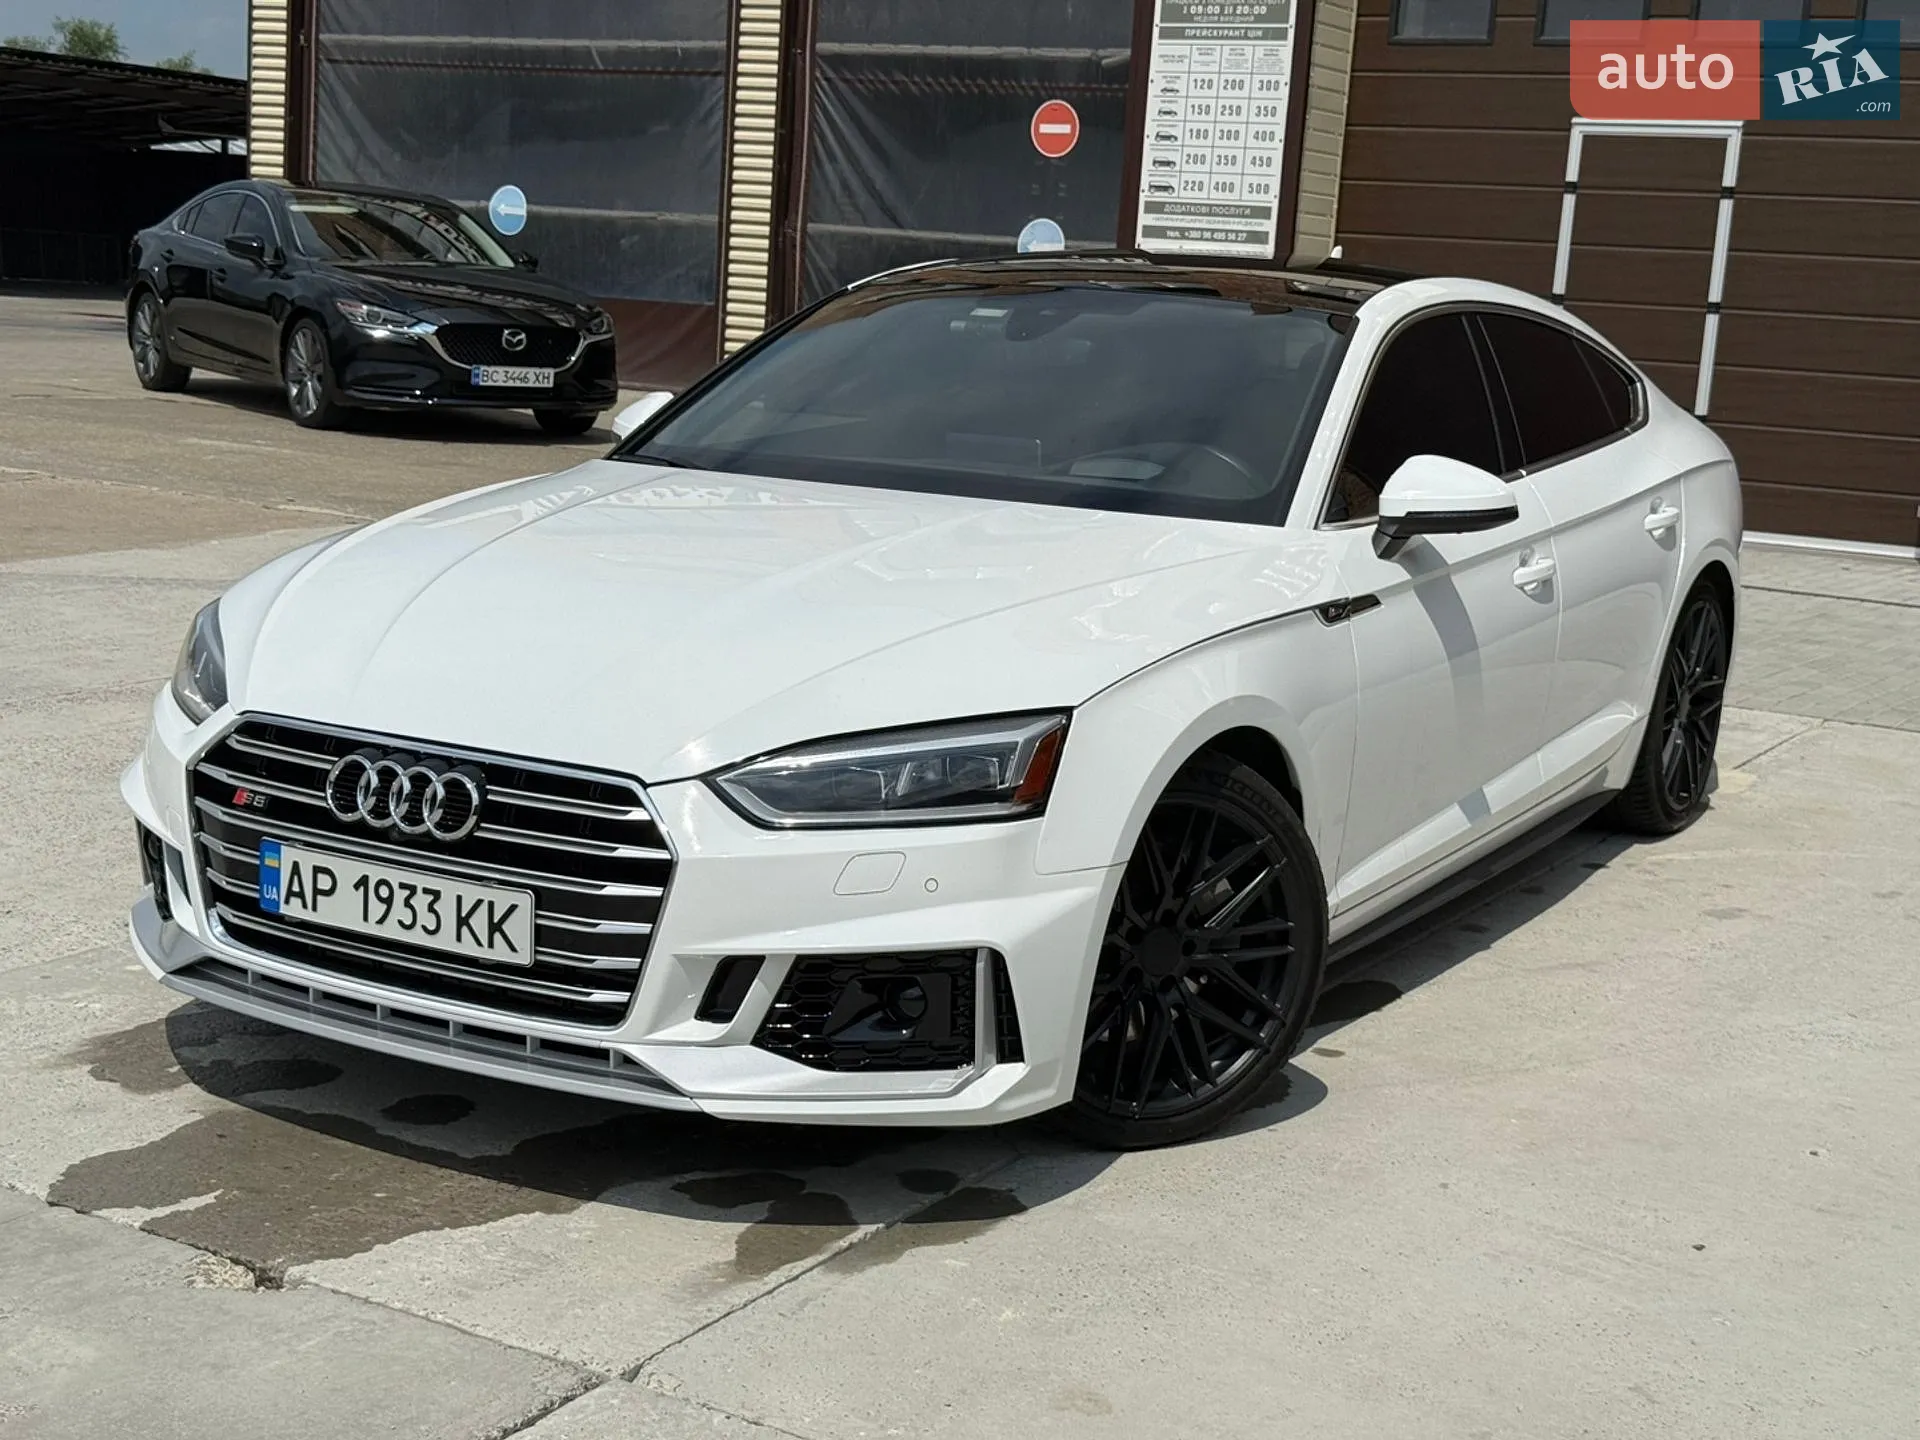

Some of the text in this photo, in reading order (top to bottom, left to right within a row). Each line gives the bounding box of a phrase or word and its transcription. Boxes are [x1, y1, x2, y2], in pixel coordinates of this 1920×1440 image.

[1236, 5, 1267, 15] 20:00
[1193, 78, 1214, 90] 120
[1222, 79, 1245, 91] 200
[1257, 79, 1280, 92] 300
[1190, 104, 1211, 116] 150
[1220, 104, 1242, 117] 250
[1254, 105, 1277, 118] 350
[1188, 128, 1209, 140] 180
[1218, 129, 1240, 141] 300
[1252, 130, 1275, 142] 400
[1185, 153, 1206, 165] 200
[1215, 154, 1237, 166] 350
[1250, 155, 1273, 168] 450
[1182, 180, 1204, 192] 220
[1213, 181, 1235, 193] 400
[1247, 182, 1270, 195] 500
[482, 369, 500, 383] BC
[502, 370, 530, 385] 3446
[533, 371, 550, 385] XH
[263, 883, 279, 901] UA
[284, 860, 520, 954] AP 1933 KK
